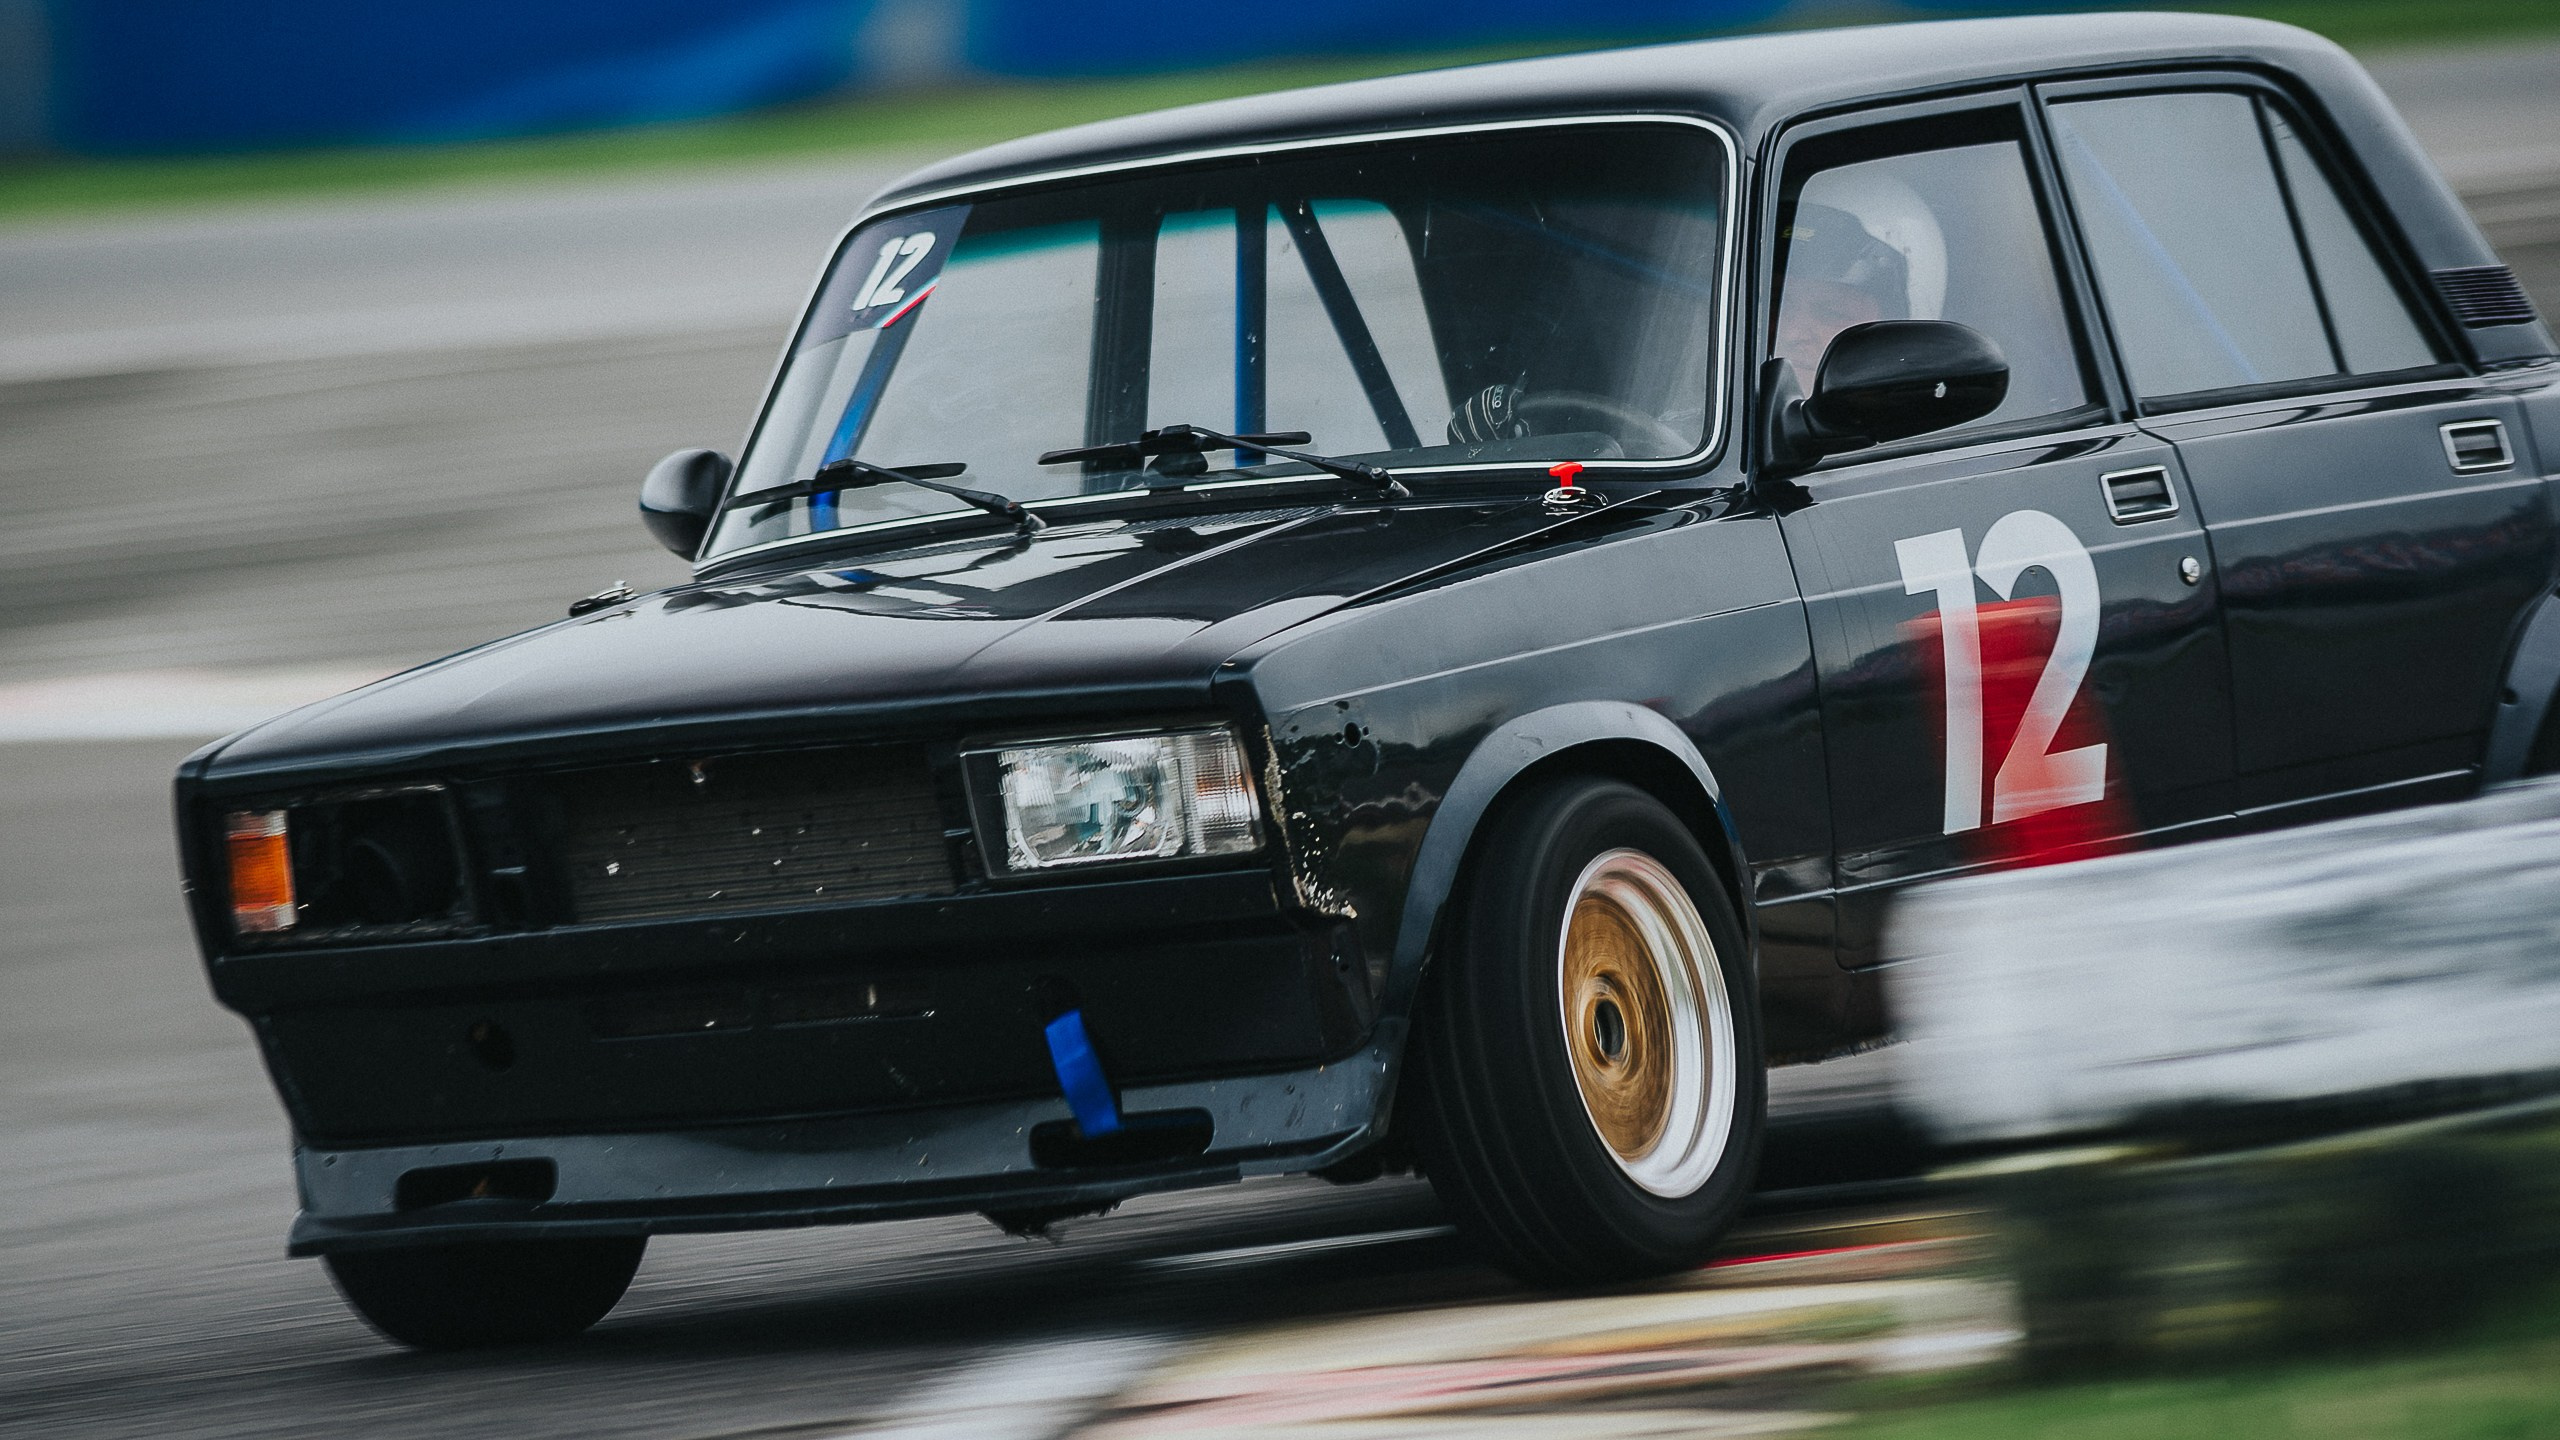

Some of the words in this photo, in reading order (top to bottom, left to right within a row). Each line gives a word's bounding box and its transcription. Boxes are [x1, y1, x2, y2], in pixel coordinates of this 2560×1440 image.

[851, 231, 937, 311] 12
[1494, 385, 1504, 408] arco
[1894, 509, 2108, 835] 12
